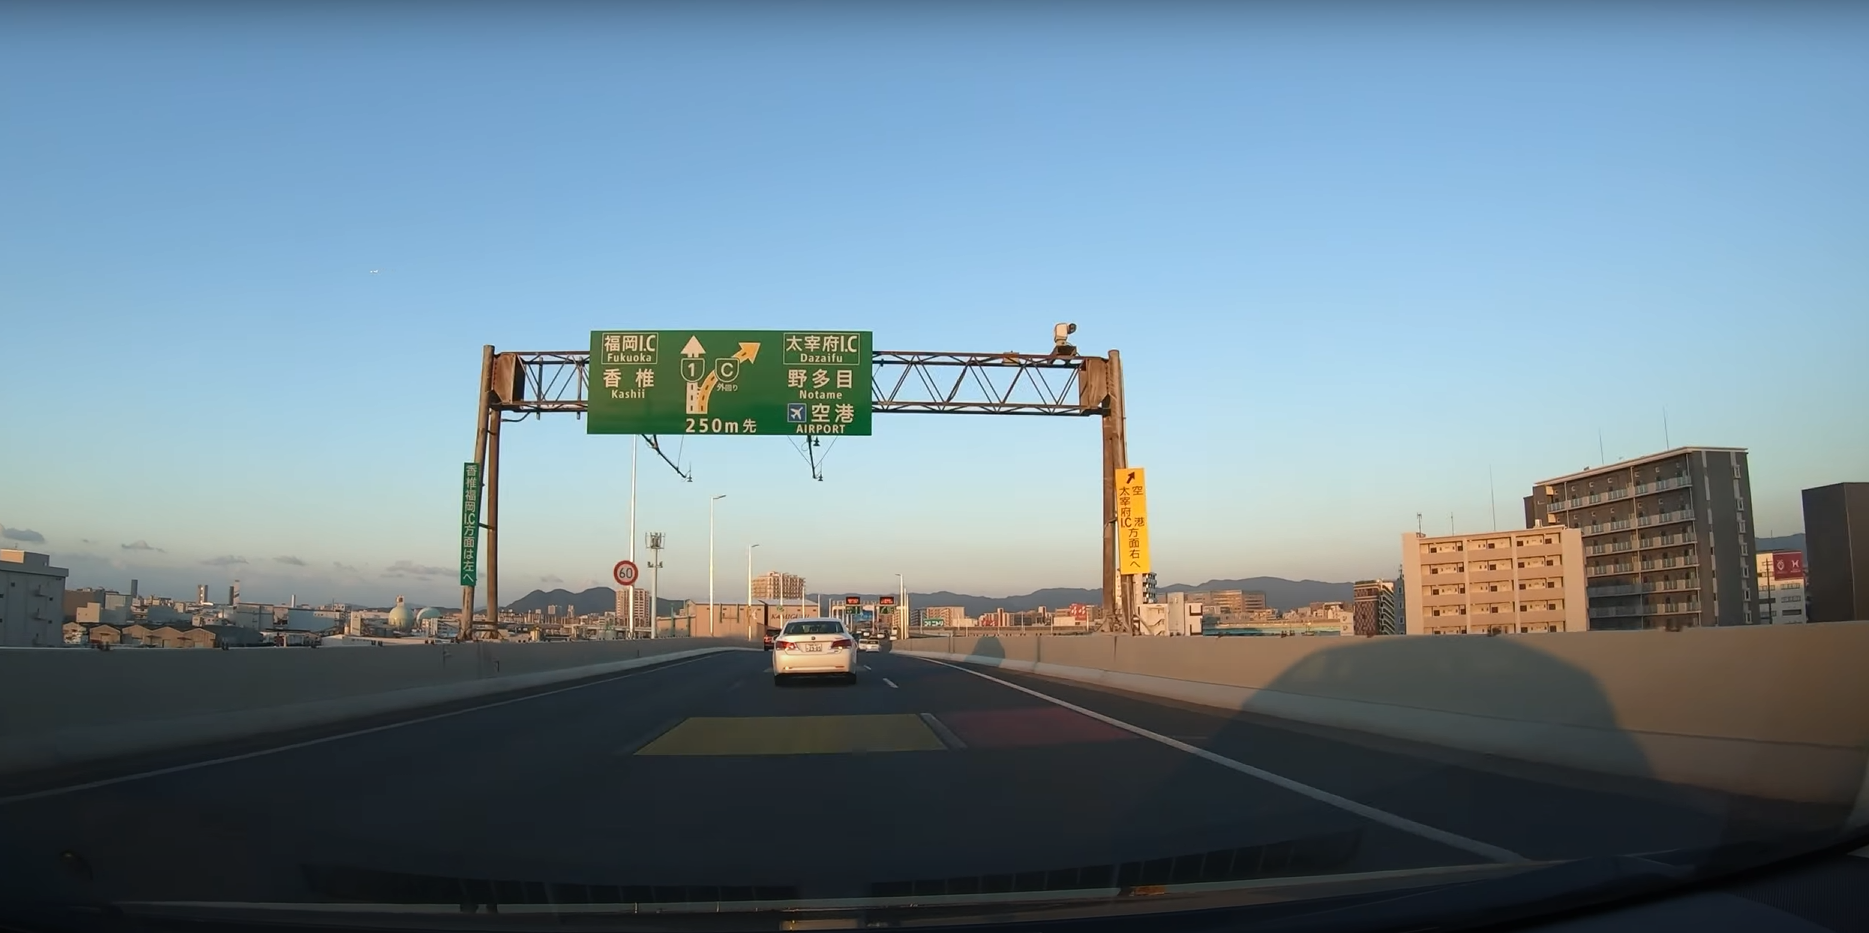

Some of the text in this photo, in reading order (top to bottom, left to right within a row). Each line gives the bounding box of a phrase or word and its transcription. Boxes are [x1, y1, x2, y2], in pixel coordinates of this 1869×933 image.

[604, 335, 656, 352] 福岡I.C
[786, 335, 857, 353] 太宰府I.C
[607, 353, 652, 362] Fukuoka
[800, 353, 843, 363] Dazaifu
[688, 363, 695, 376] 1
[720, 362, 734, 376] C
[788, 369, 853, 389] 野多目
[716, 383, 738, 392] 外回り
[611, 389, 646, 399] Kashii
[799, 389, 842, 400] Notame
[811, 403, 855, 423] 空港
[796, 424, 845, 434] AIRPORT
[619, 567, 633, 579] 60
